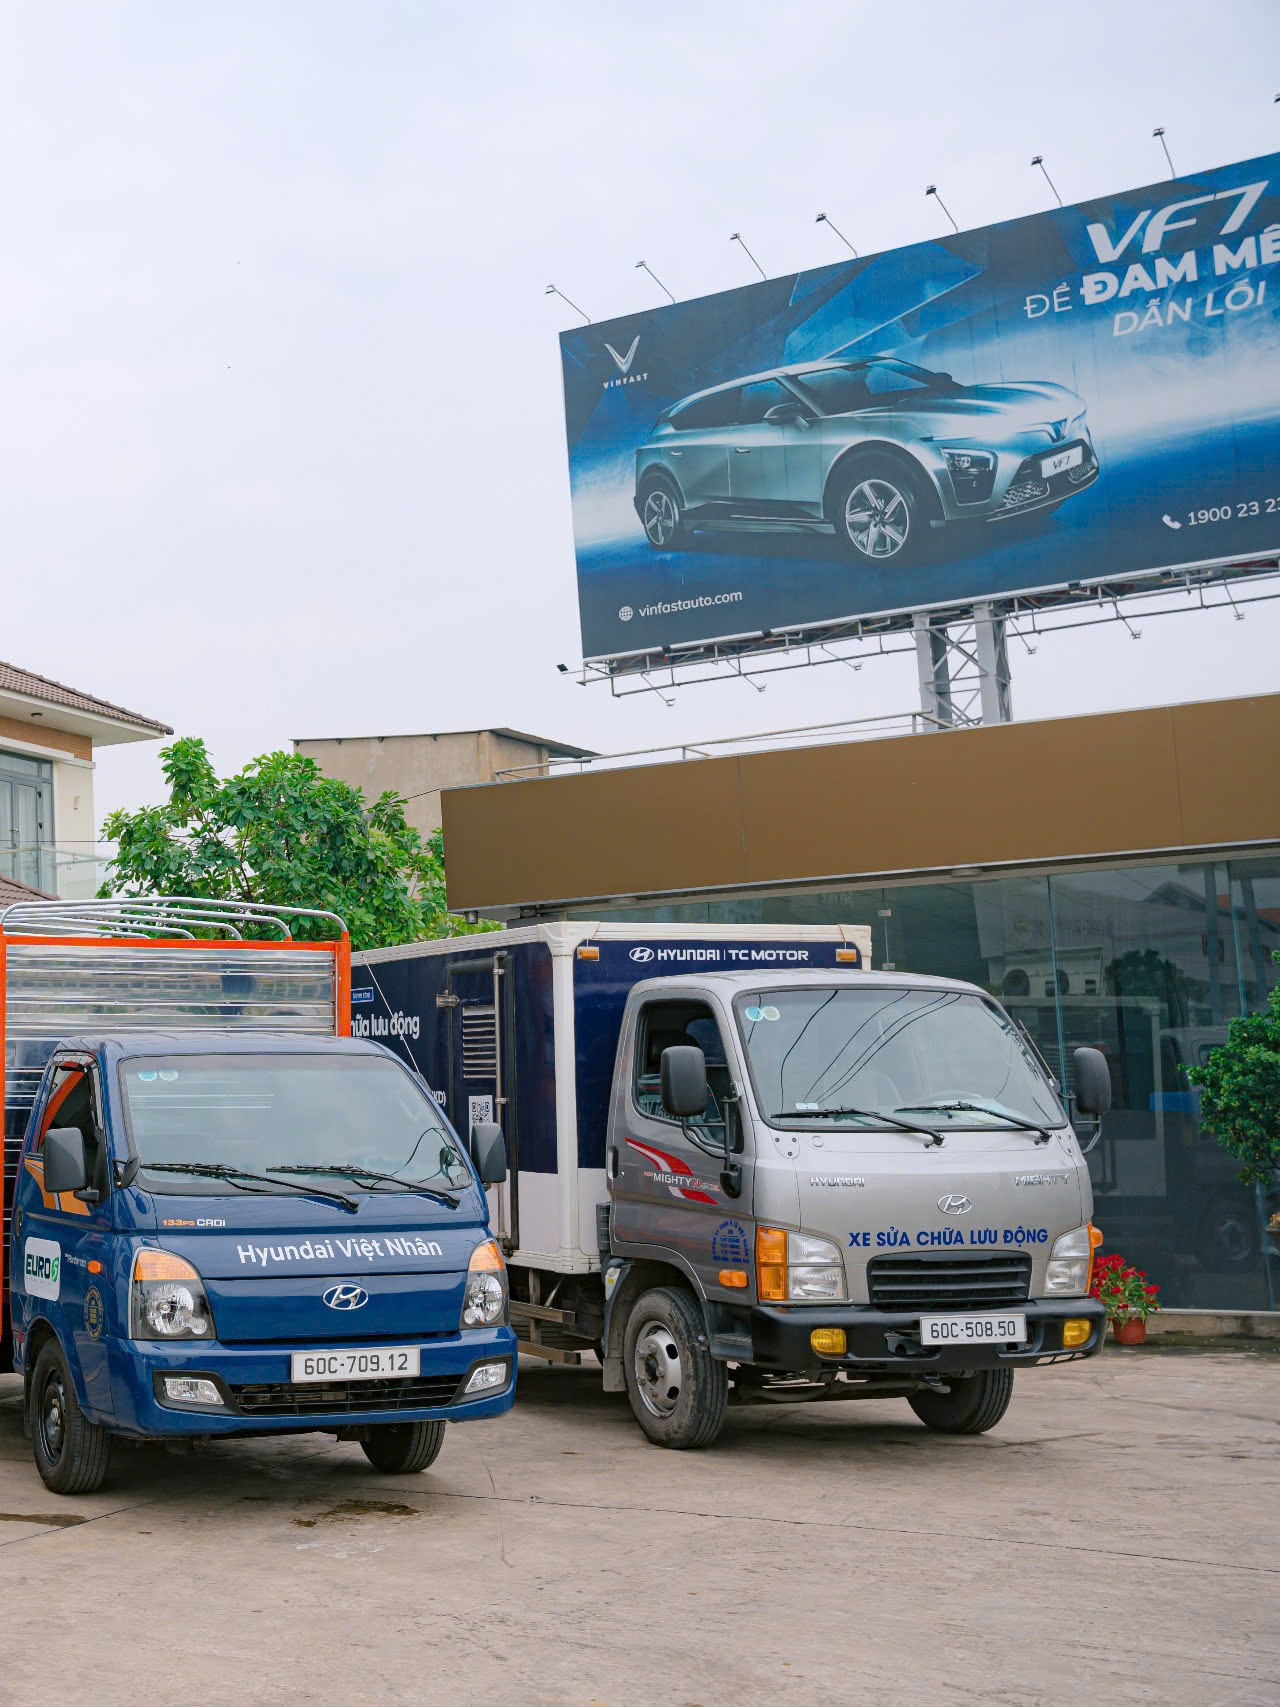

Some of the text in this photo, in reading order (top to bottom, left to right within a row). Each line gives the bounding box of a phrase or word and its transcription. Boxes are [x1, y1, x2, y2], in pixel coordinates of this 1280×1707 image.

[1024, 282, 1072, 318] ĐỂ
[1080, 251, 1198, 305] ĐAM
[1113, 279, 1266, 336] DẪN LỐI
[603, 373, 648, 388] VINFAST
[1188, 505, 1232, 525] 1900
[1237, 502, 1260, 518] 23
[639, 592, 743, 617] vinfastauto.com
[658, 949, 809, 961] HYUNDAI TC MOTOR
[371, 1014, 388, 1036] lưu
[390, 1011, 420, 1041] động
[653, 1172, 692, 1187] MIGHTY
[810, 1177, 865, 1187] HYUNDAI
[1015, 1174, 1070, 1186] MIGHTY
[848, 1226, 1049, 1248] XE SỬA CHỮA LƯU ĐỘNG
[237, 1237, 443, 1266] Hyundai Việt Nhân
[930, 1321, 1016, 1339] 60C-508.50
[304, 1353, 408, 1376] 60C-709.12
